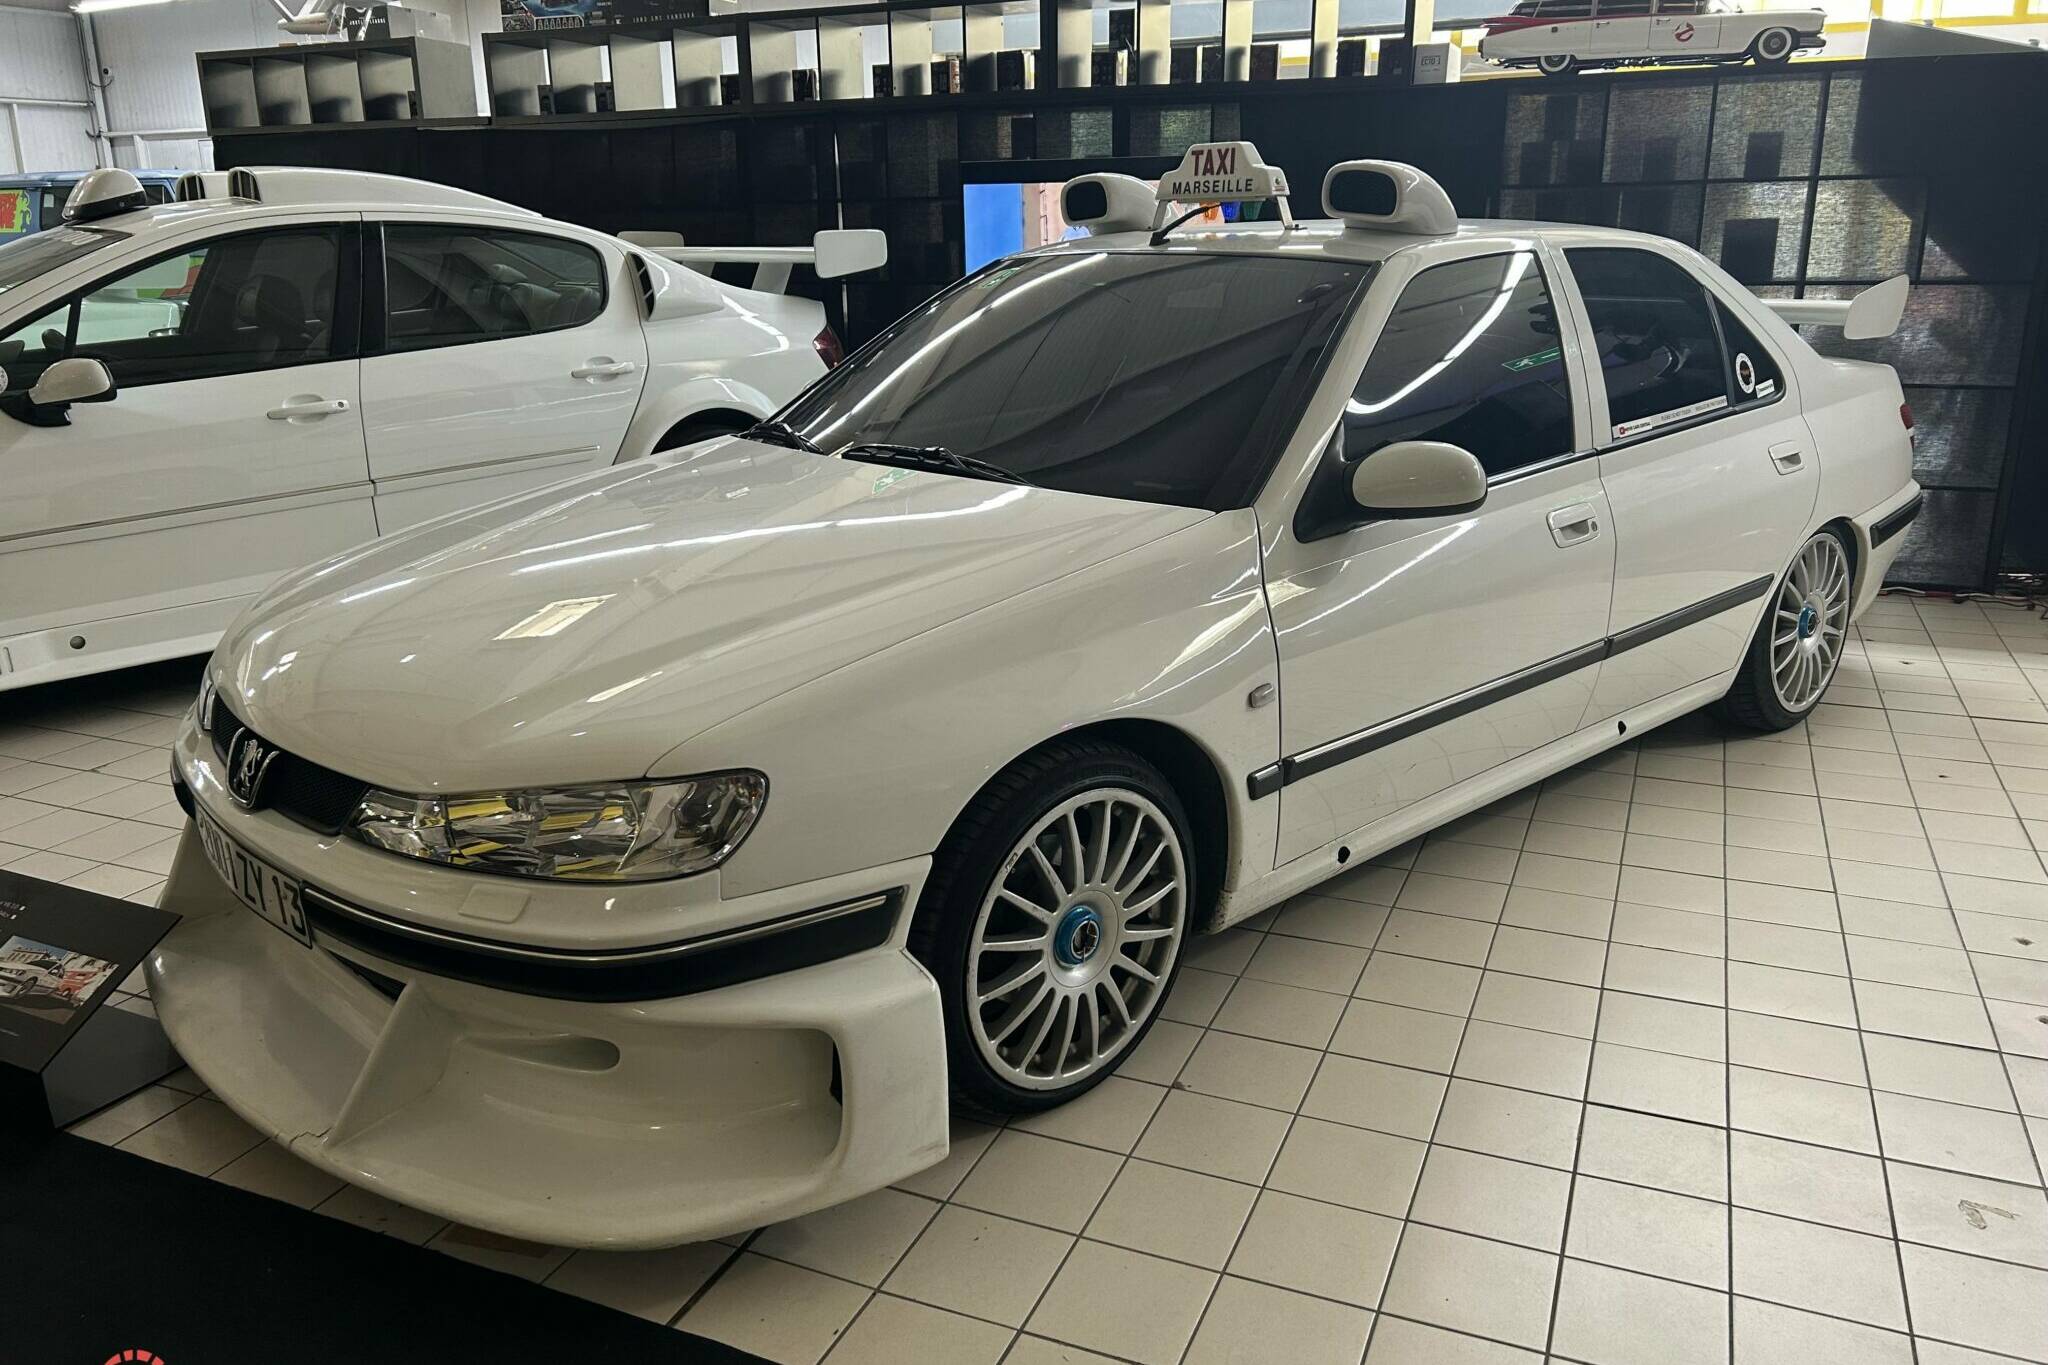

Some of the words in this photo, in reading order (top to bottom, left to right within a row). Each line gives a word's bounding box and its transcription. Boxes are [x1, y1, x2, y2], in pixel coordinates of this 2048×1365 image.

[1191, 147, 1236, 176] TAXI
[1172, 178, 1254, 195] MARSEILLE
[271, 874, 308, 937] 13
